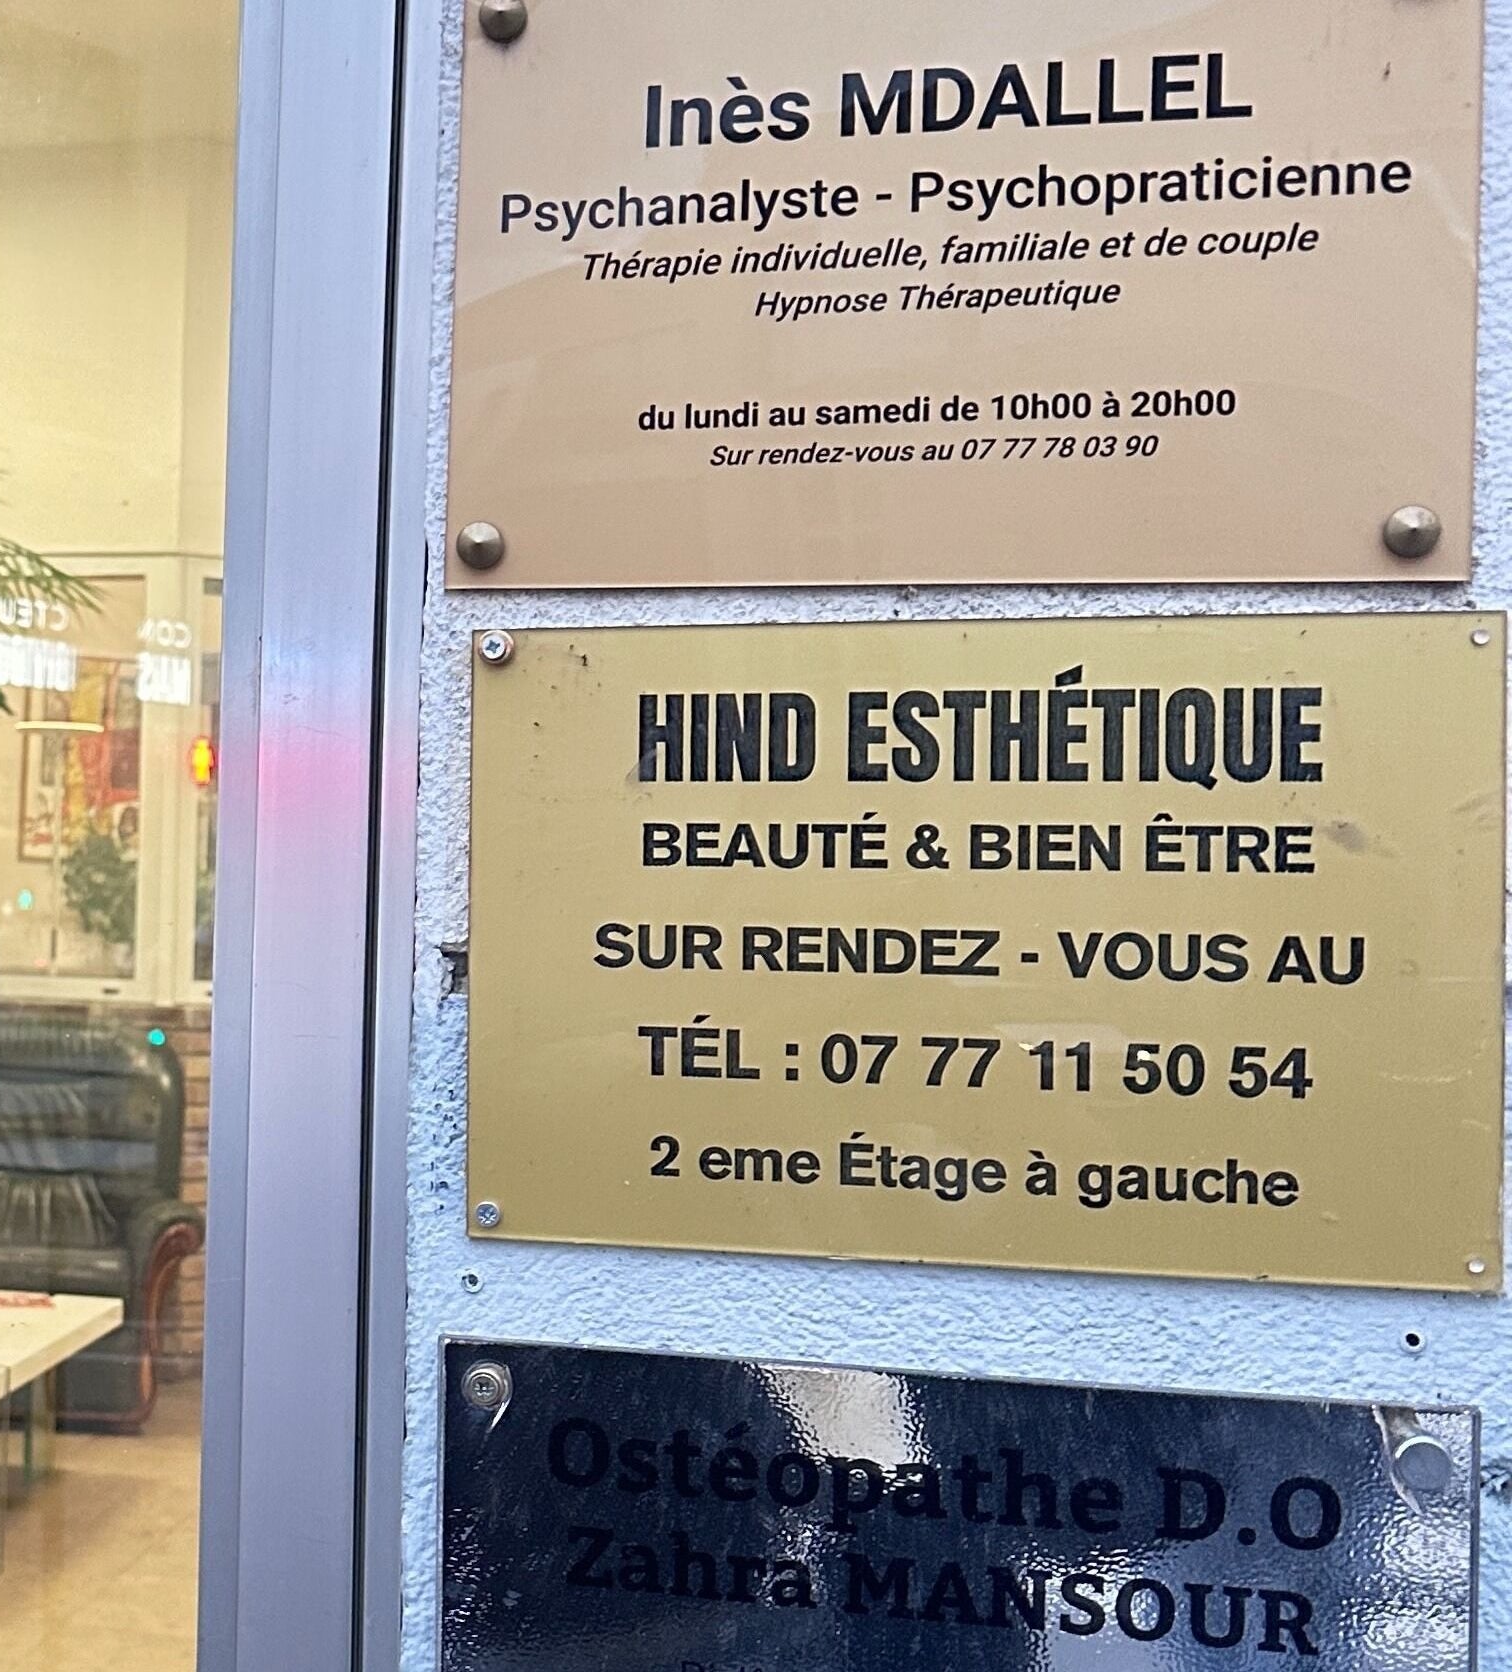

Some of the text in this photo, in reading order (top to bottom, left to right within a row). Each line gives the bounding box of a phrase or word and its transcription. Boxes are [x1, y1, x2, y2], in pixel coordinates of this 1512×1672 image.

[645, 52, 1253, 149] Inès MDALLEL
[501, 178, 859, 242] Psychanalyste
[910, 155, 1412, 221] Psychopraticienne
[583, 221, 1319, 284] Thérapie individuelle, familiale et de couple
[754, 279, 1121, 323] Hypnose Thérapeutique
[638, 389, 1236, 431] du lundi au samedi de 10h00 à 20h00
[709, 434, 1159, 467] Sur rendez-vous au 07 77 78 03 90
[637, 664, 1324, 791] HIND ESTHÉTIQUE
[642, 811, 1316, 874] BEAUTÉ & BIEN ÊTRE
[593, 922, 723, 970] SUR
[741, 926, 1001, 977] RENDEZ
[1056, 931, 1249, 983] VOUS
[1266, 935, 1365, 986] AU
[637, 1014, 761, 1080] TÉL
[820, 1033, 898, 1085] 07
[921, 1036, 1001, 1088] 77
[1028, 1040, 1091, 1092] 11
[1122, 1043, 1205, 1097] 50
[1228, 1046, 1314, 1100] 54
[650, 1131, 1299, 1209] 2 eme Étage à gauche
[546, 1415, 1341, 1551] Ostéopathe D.O
[565, 1526, 1318, 1657] Zahra MANSOUR
